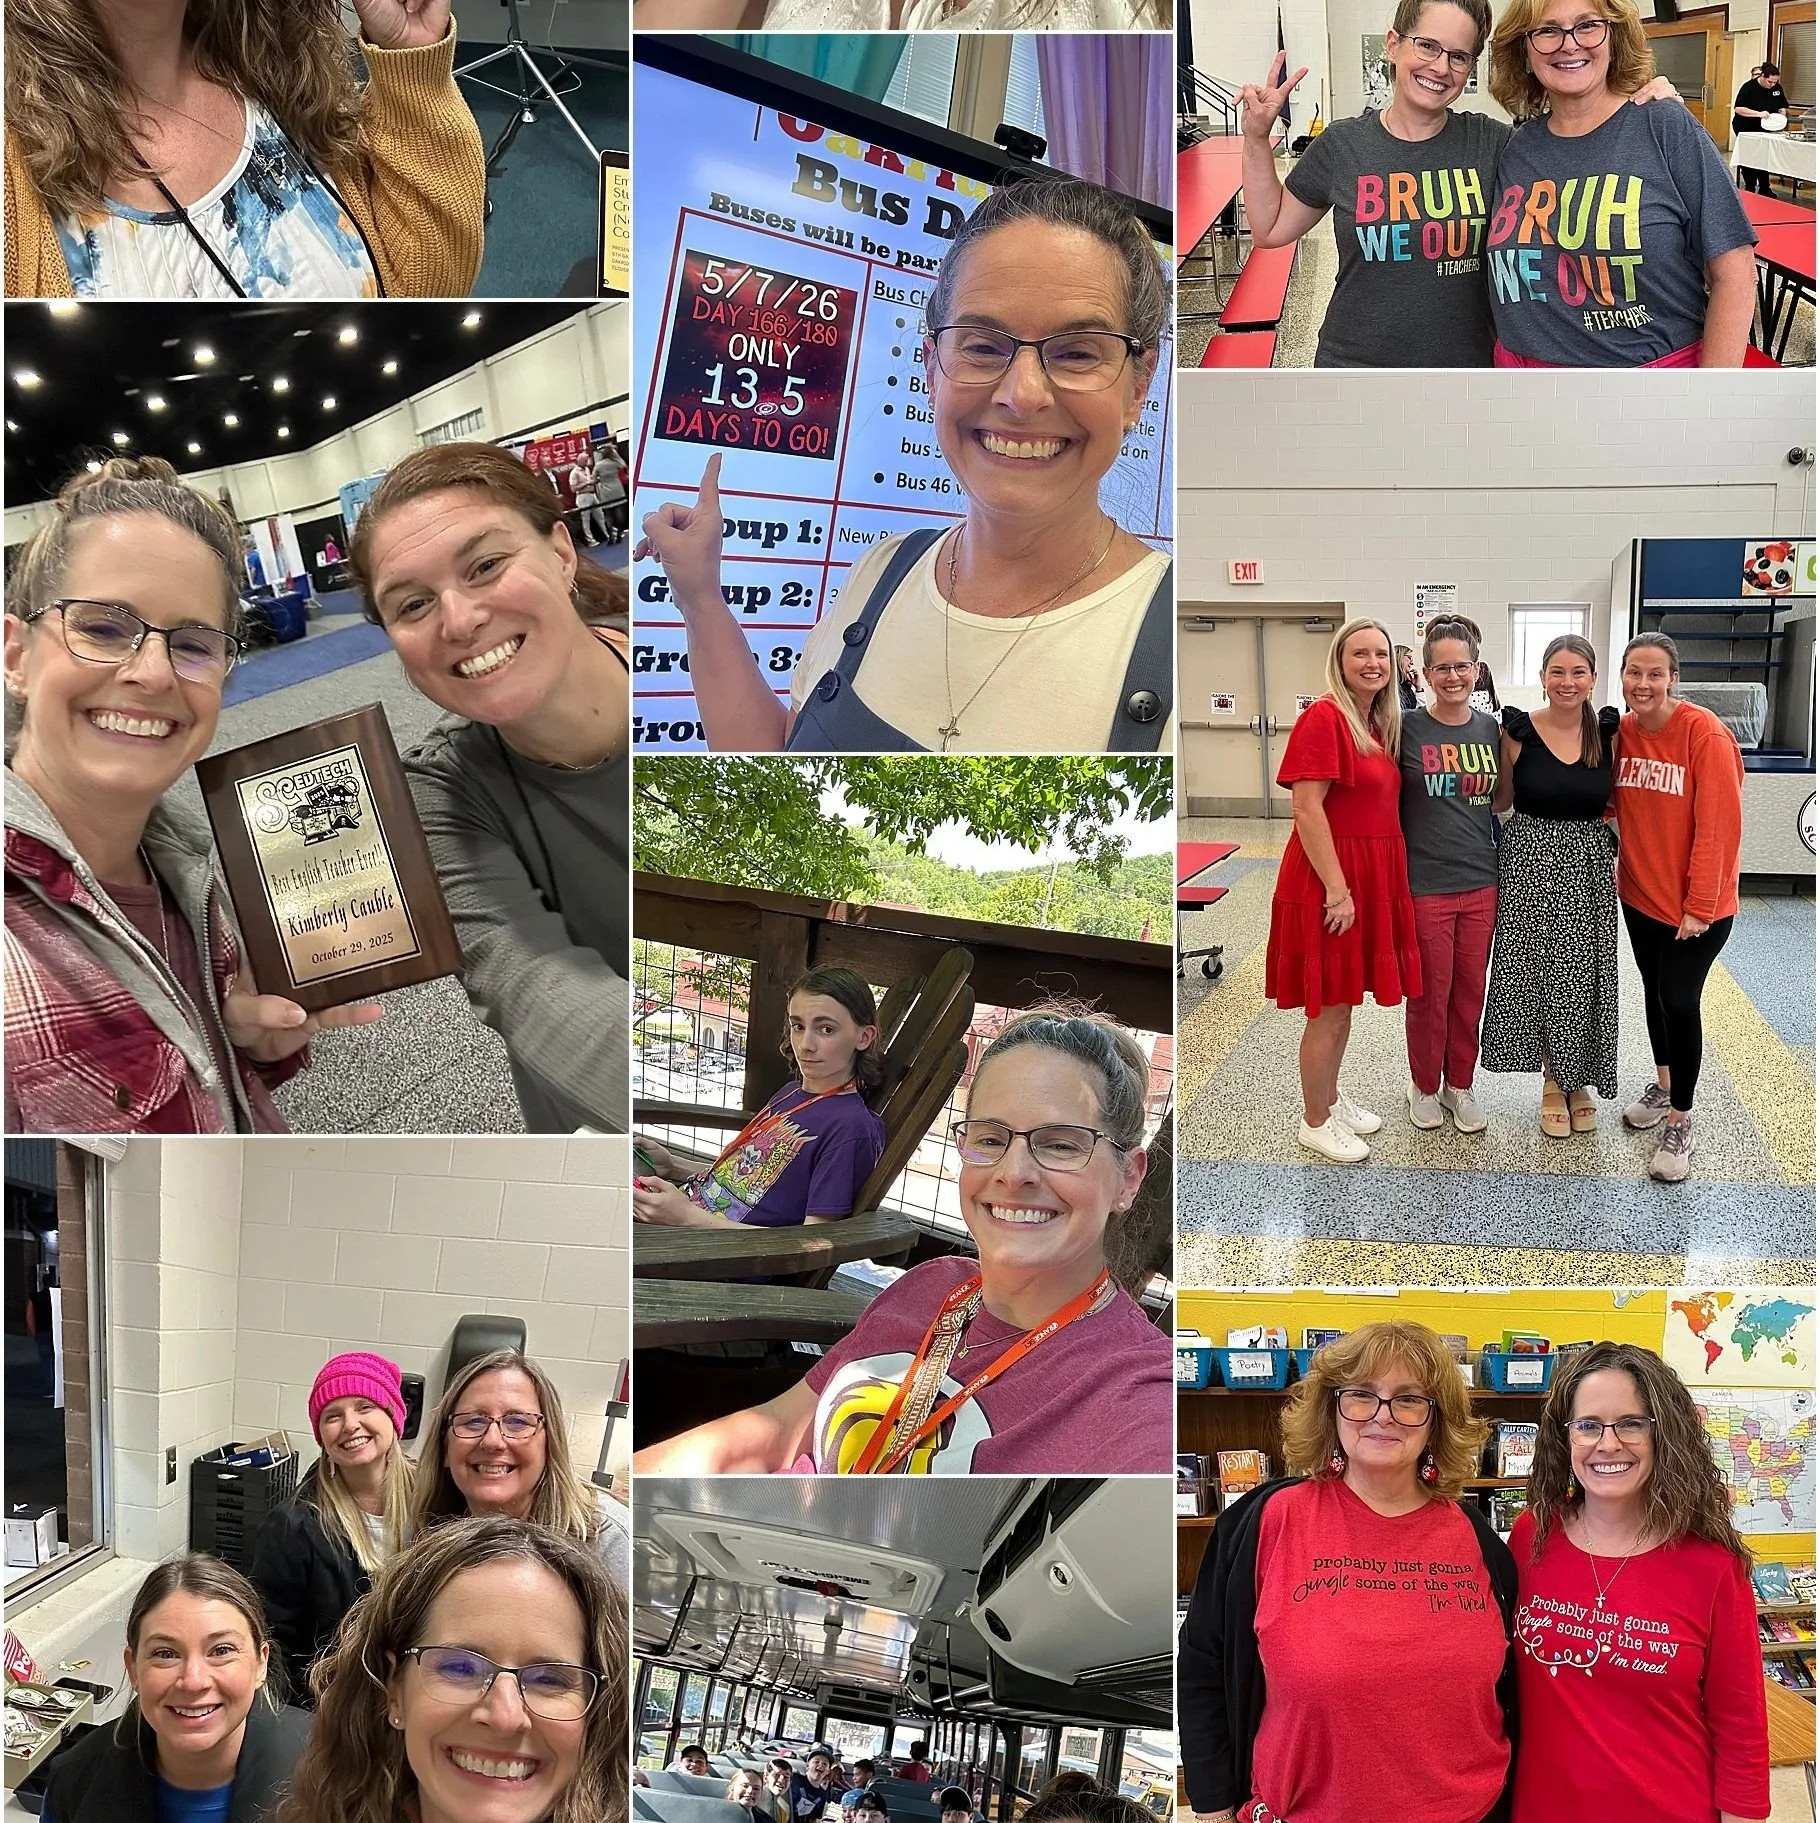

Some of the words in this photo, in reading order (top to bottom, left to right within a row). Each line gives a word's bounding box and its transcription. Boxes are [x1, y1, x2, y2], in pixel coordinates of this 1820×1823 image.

[792, 153, 911, 226] Bus
[1355, 168, 1486, 223] BRUH
[709, 192, 797, 233] Buses
[803, 223, 855, 250] will
[861, 235, 891, 259] be
[1488, 173, 1643, 251] BRUH
[1356, 223, 1412, 262] WE
[1422, 218, 1486, 260] OUT
[701, 259, 839, 321] 5/7/26
[1488, 249, 1547, 305] WE
[1557, 252, 1643, 307] OUT
[693, 296, 743, 327] DAY
[749, 309, 838, 347] 166/180
[728, 333, 800, 370] ONLY
[665, 405, 741, 443] DAYS
[751, 417, 781, 448] TO
[789, 425, 829, 454] GO!
[896, 473, 927, 491] Bus
[1234, 562, 1257, 580] EXIT
[1421, 743, 1498, 774] BRUH
[1424, 774, 1456, 796] WE
[1461, 774, 1498, 796] OUT
[288, 900, 347, 937] Kimberly
[350, 886, 394, 918] Cauble
[312, 946, 347, 964] October
[350, 940, 366, 954] 29,
[369, 932, 394, 950] 2025
[1504, 1425, 1517, 1433] ALLY
[1517, 1426, 1537, 1434] CARTER
[1313, 1556, 1386, 1573] probably
[1391, 1559, 1424, 1574] just
[1429, 1561, 1473, 1576] gonna
[1355, 1578, 1397, 1590] some
[1401, 1576, 1417, 1590] of
[1423, 1577, 1448, 1592] the
[1451, 1579, 1480, 1594] way
[1530, 1594, 1587, 1621] Probably
[1590, 1608, 1619, 1626] just
[1623, 1615, 1670, 1636] gonna
[1556, 1621, 1594, 1641] some
[1618, 1633, 1643, 1651] the
[1647, 1641, 1679, 1659] way
